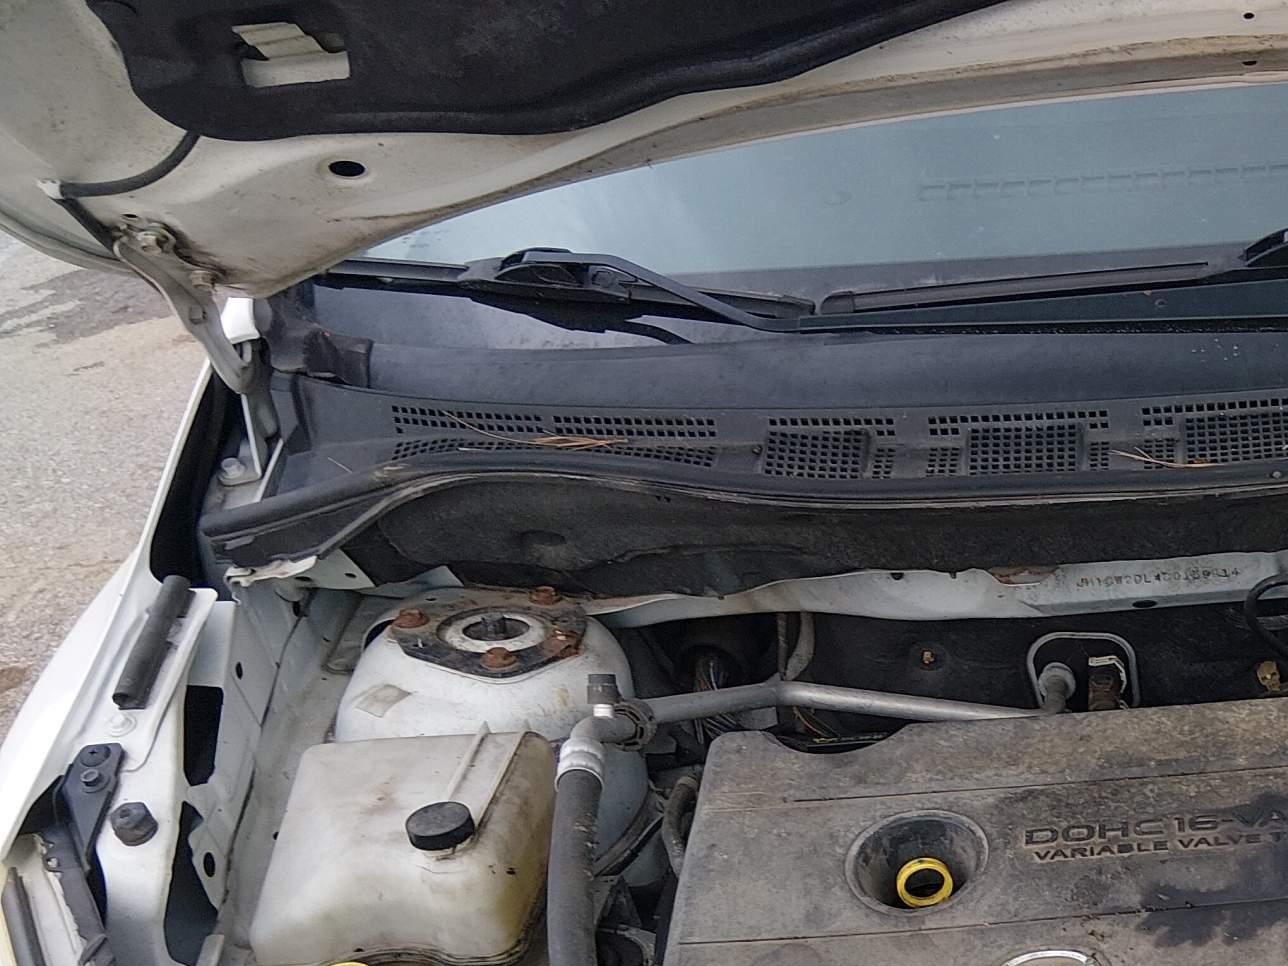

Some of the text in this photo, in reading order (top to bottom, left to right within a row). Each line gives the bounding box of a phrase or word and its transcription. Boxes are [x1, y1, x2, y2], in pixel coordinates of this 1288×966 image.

[1025, 817, 1164, 845] DOHC
[1034, 839, 1168, 861] VARIABLE
[1179, 832, 1261, 849] VALVE
